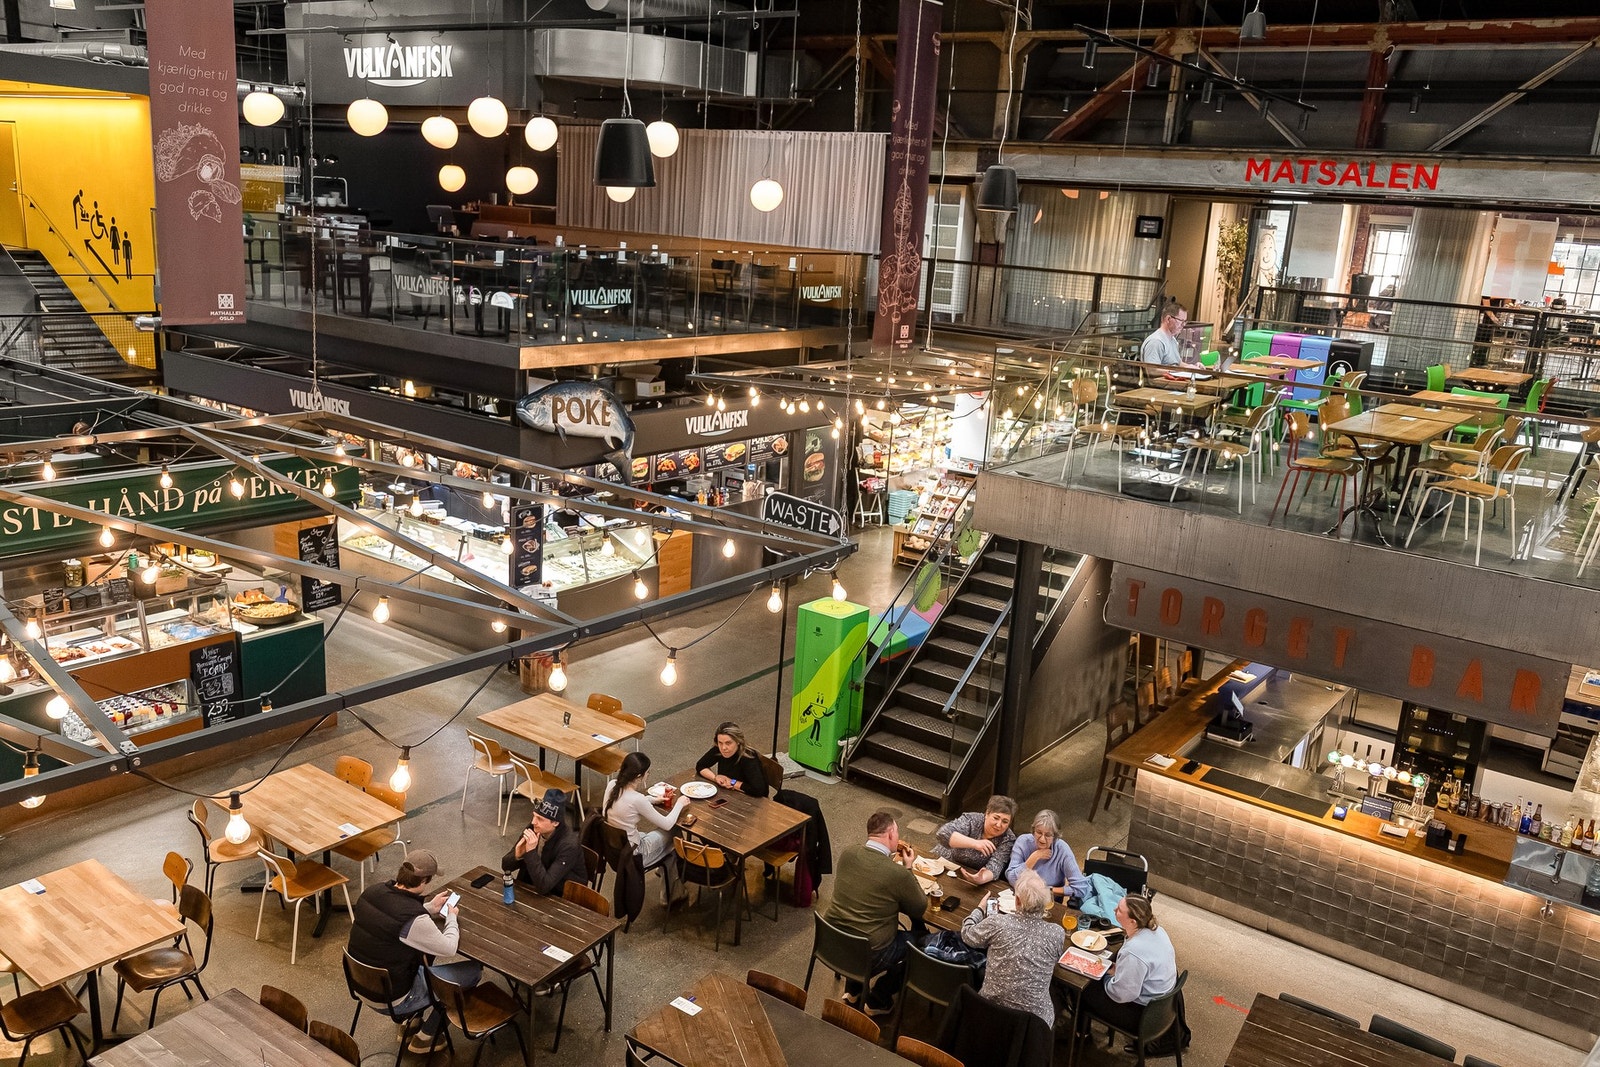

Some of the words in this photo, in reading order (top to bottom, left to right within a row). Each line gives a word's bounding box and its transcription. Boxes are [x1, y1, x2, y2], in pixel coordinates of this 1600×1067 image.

[179, 45, 207, 60] Med
[343, 40, 454, 79] VULKANFISK
[158, 60, 215, 80] kjærlighet
[218, 70, 229, 81] til
[160, 82, 185, 95] god
[188, 87, 210, 97] mat
[212, 90, 228, 102] og
[178, 101, 212, 115] drikke
[1244, 157, 1441, 191] MATSALEN
[394, 275, 450, 297] VULKANFISK
[571, 286, 632, 306] VULKANFISK
[802, 284, 842, 300] VULKANFISK
[551, 395, 611, 427] POKE
[685, 409, 749, 435] VULKANFISK
[193, 481, 223, 513] på
[771, 499, 830, 533] WASTE
[1126, 577, 1357, 671] TORGET
[1408, 644, 1543, 716] BAR
